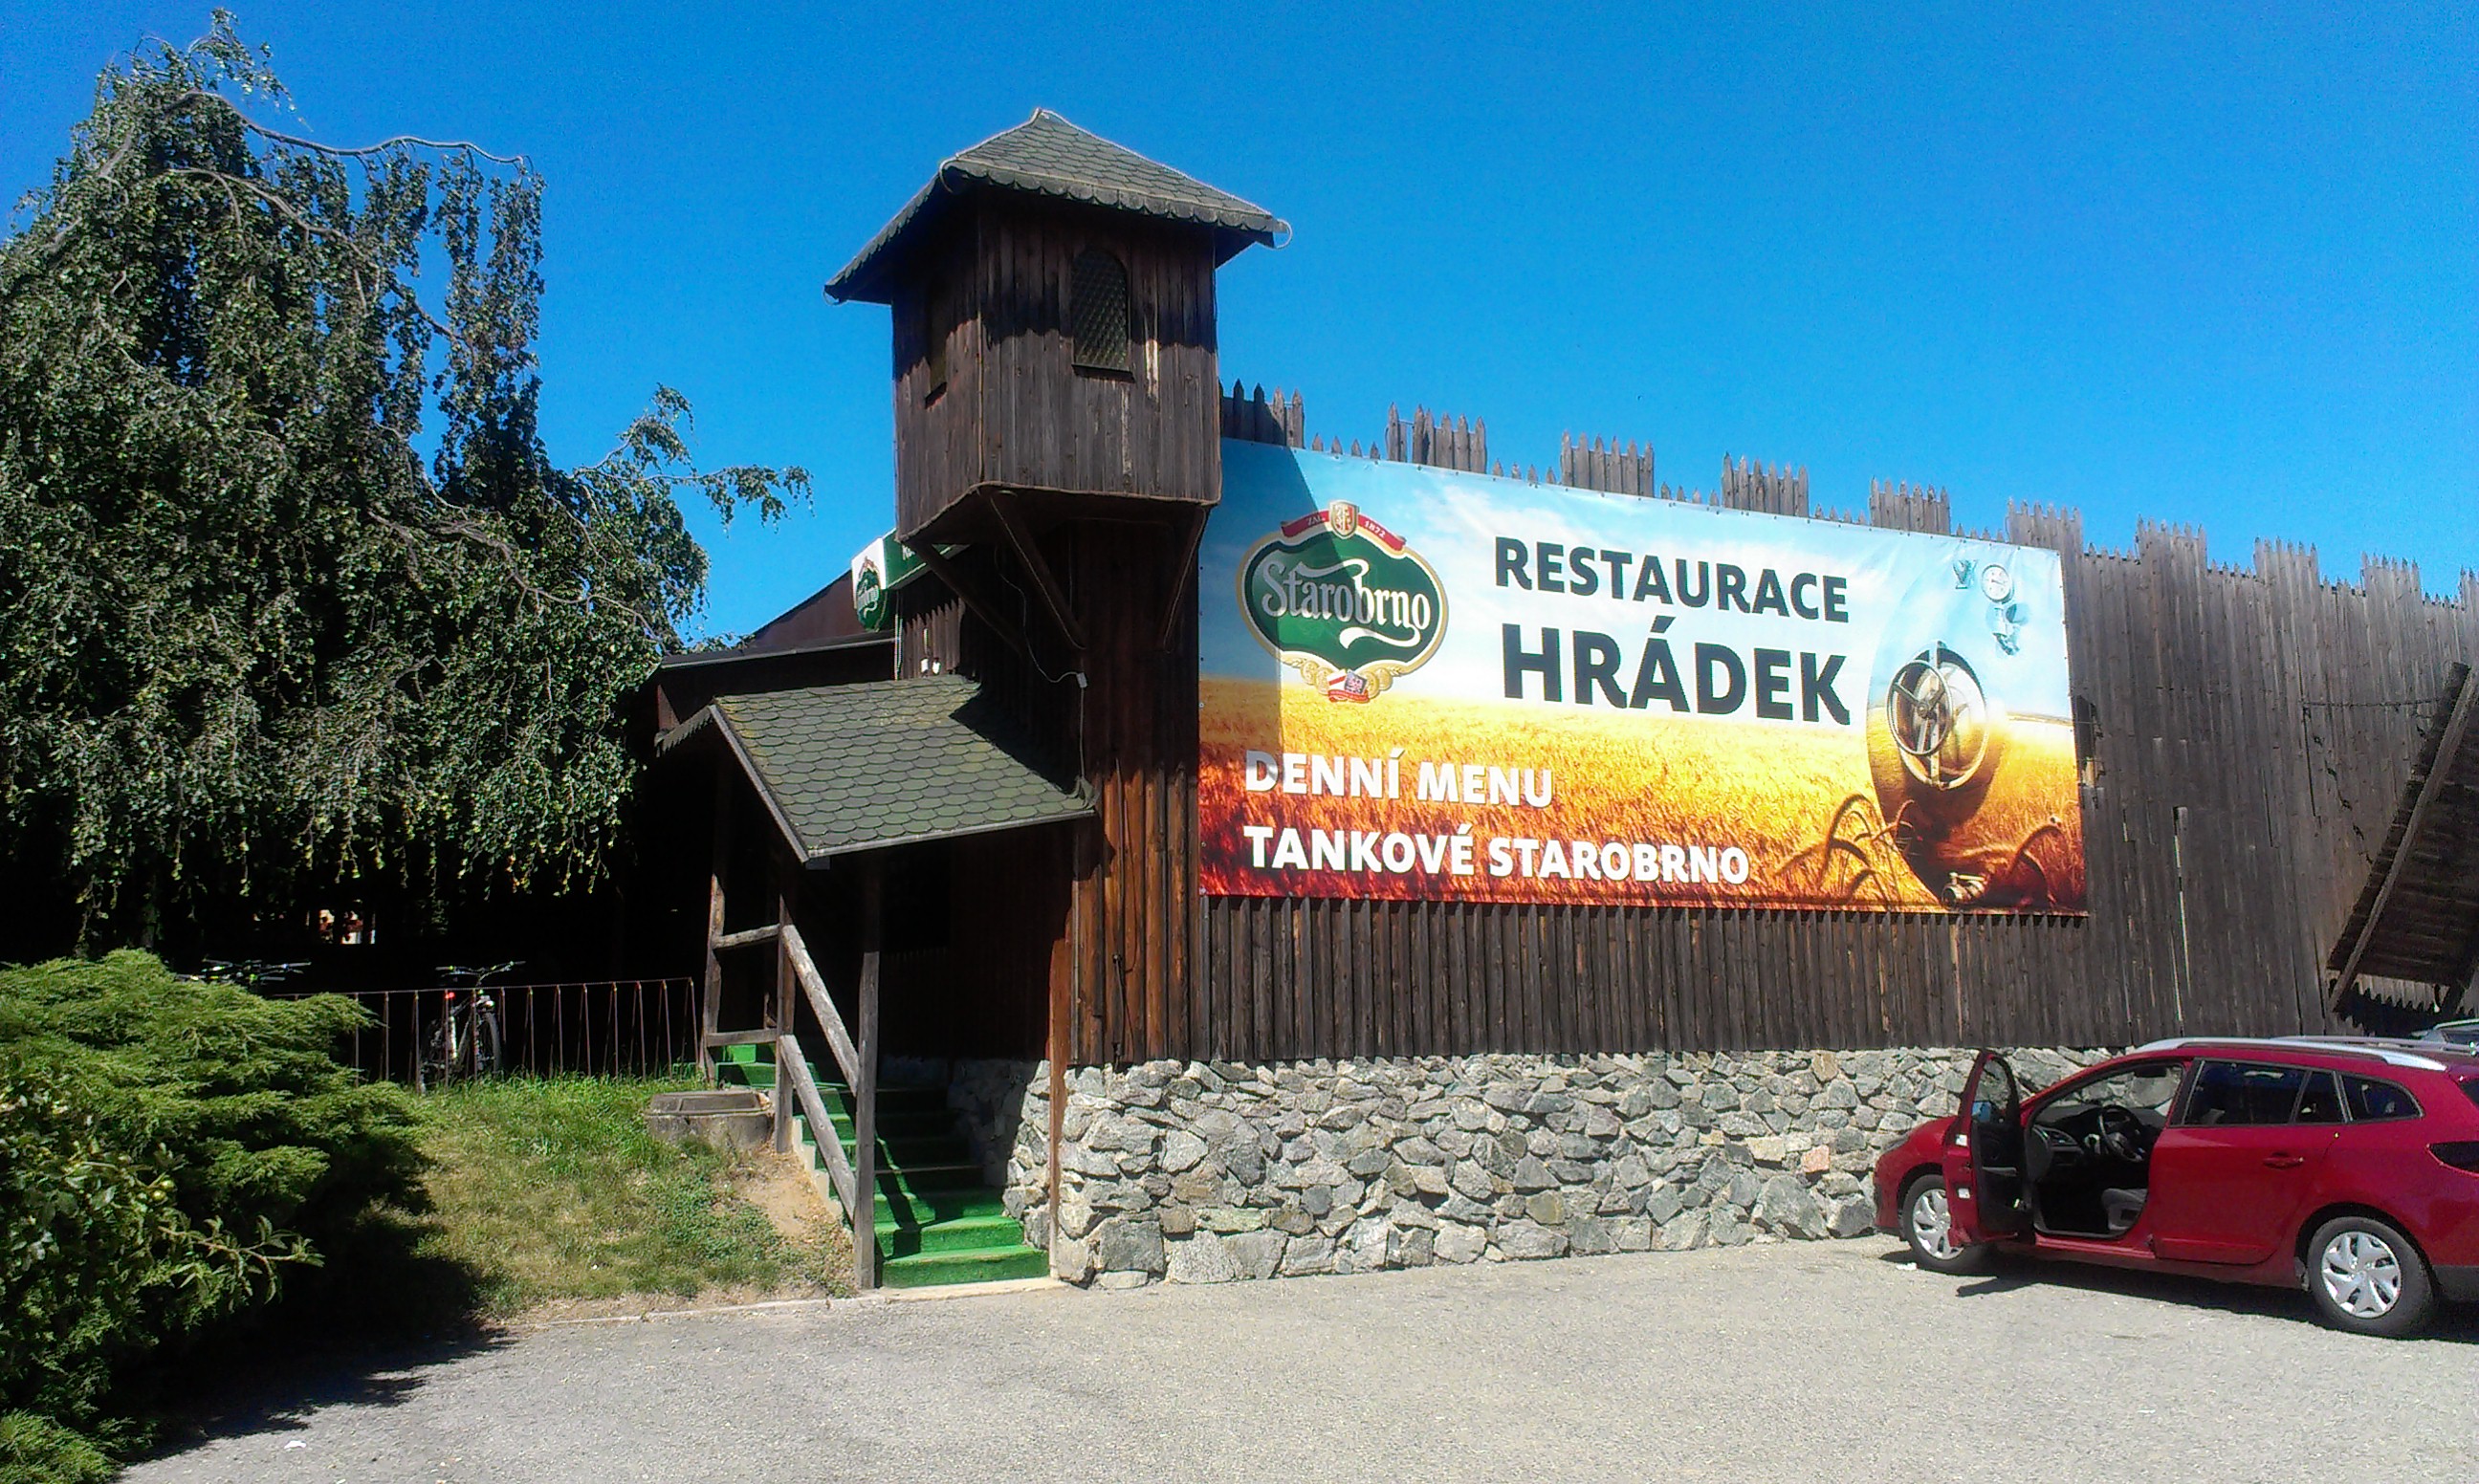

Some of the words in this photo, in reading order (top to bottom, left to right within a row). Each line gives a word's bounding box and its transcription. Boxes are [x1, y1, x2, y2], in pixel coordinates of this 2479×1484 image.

[1261, 558, 1431, 649] Starobrno
[1495, 536, 1850, 623] RESTAURACE
[1503, 615, 1851, 726] HRÁDEK
[1245, 748, 1405, 799] DENNÍ
[1417, 761, 1553, 807] MENU
[1243, 823, 1474, 876] TANKOVÉ
[1488, 837, 1749, 884] STAROBRNO
